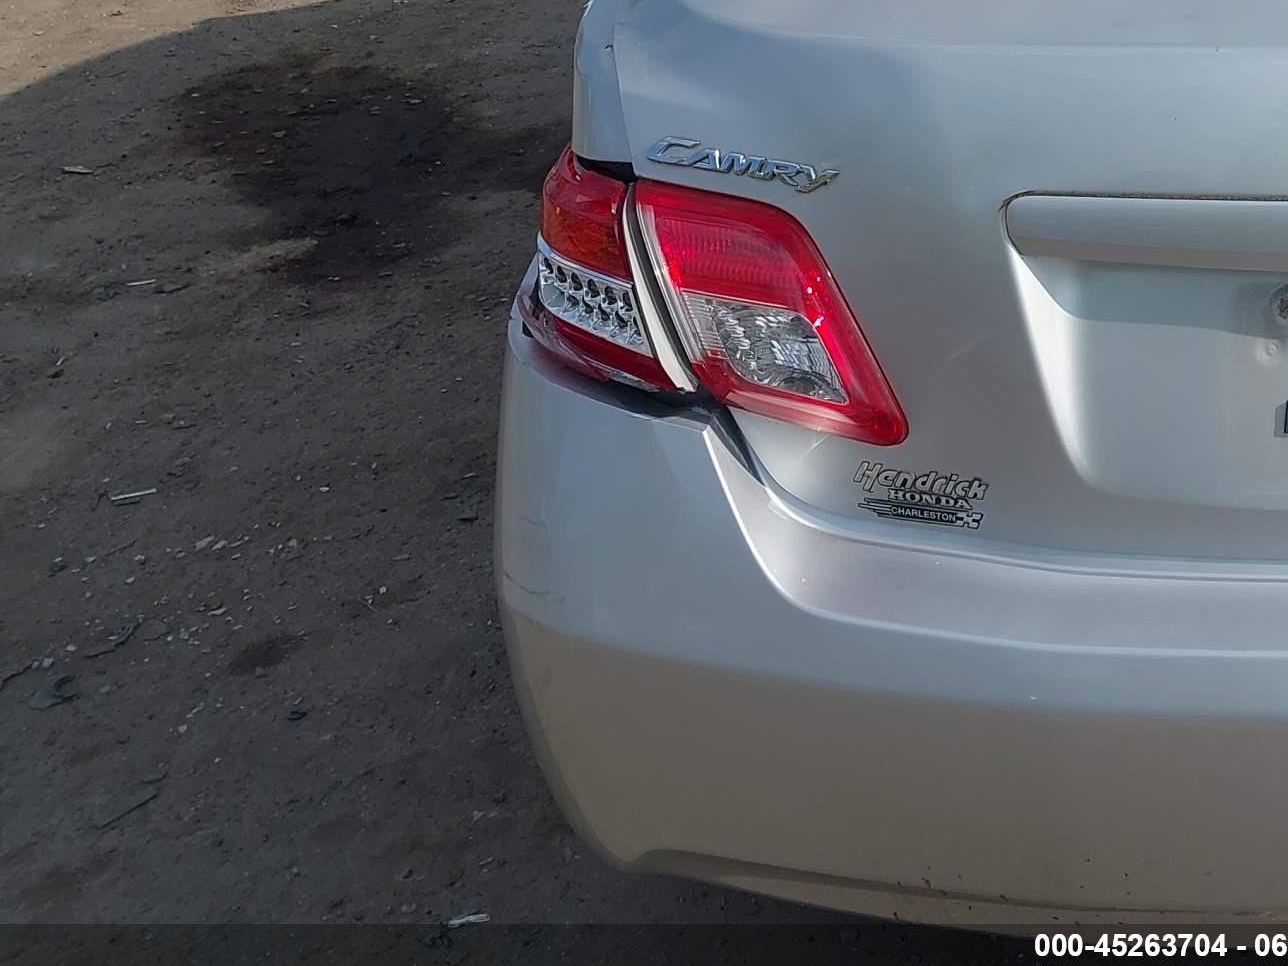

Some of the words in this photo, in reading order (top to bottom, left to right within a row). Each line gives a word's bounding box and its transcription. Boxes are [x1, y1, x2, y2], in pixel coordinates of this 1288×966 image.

[853, 460, 988, 500] Hendrick
[888, 488, 973, 510] HONDA
[890, 506, 957, 522] CHARLESTON
